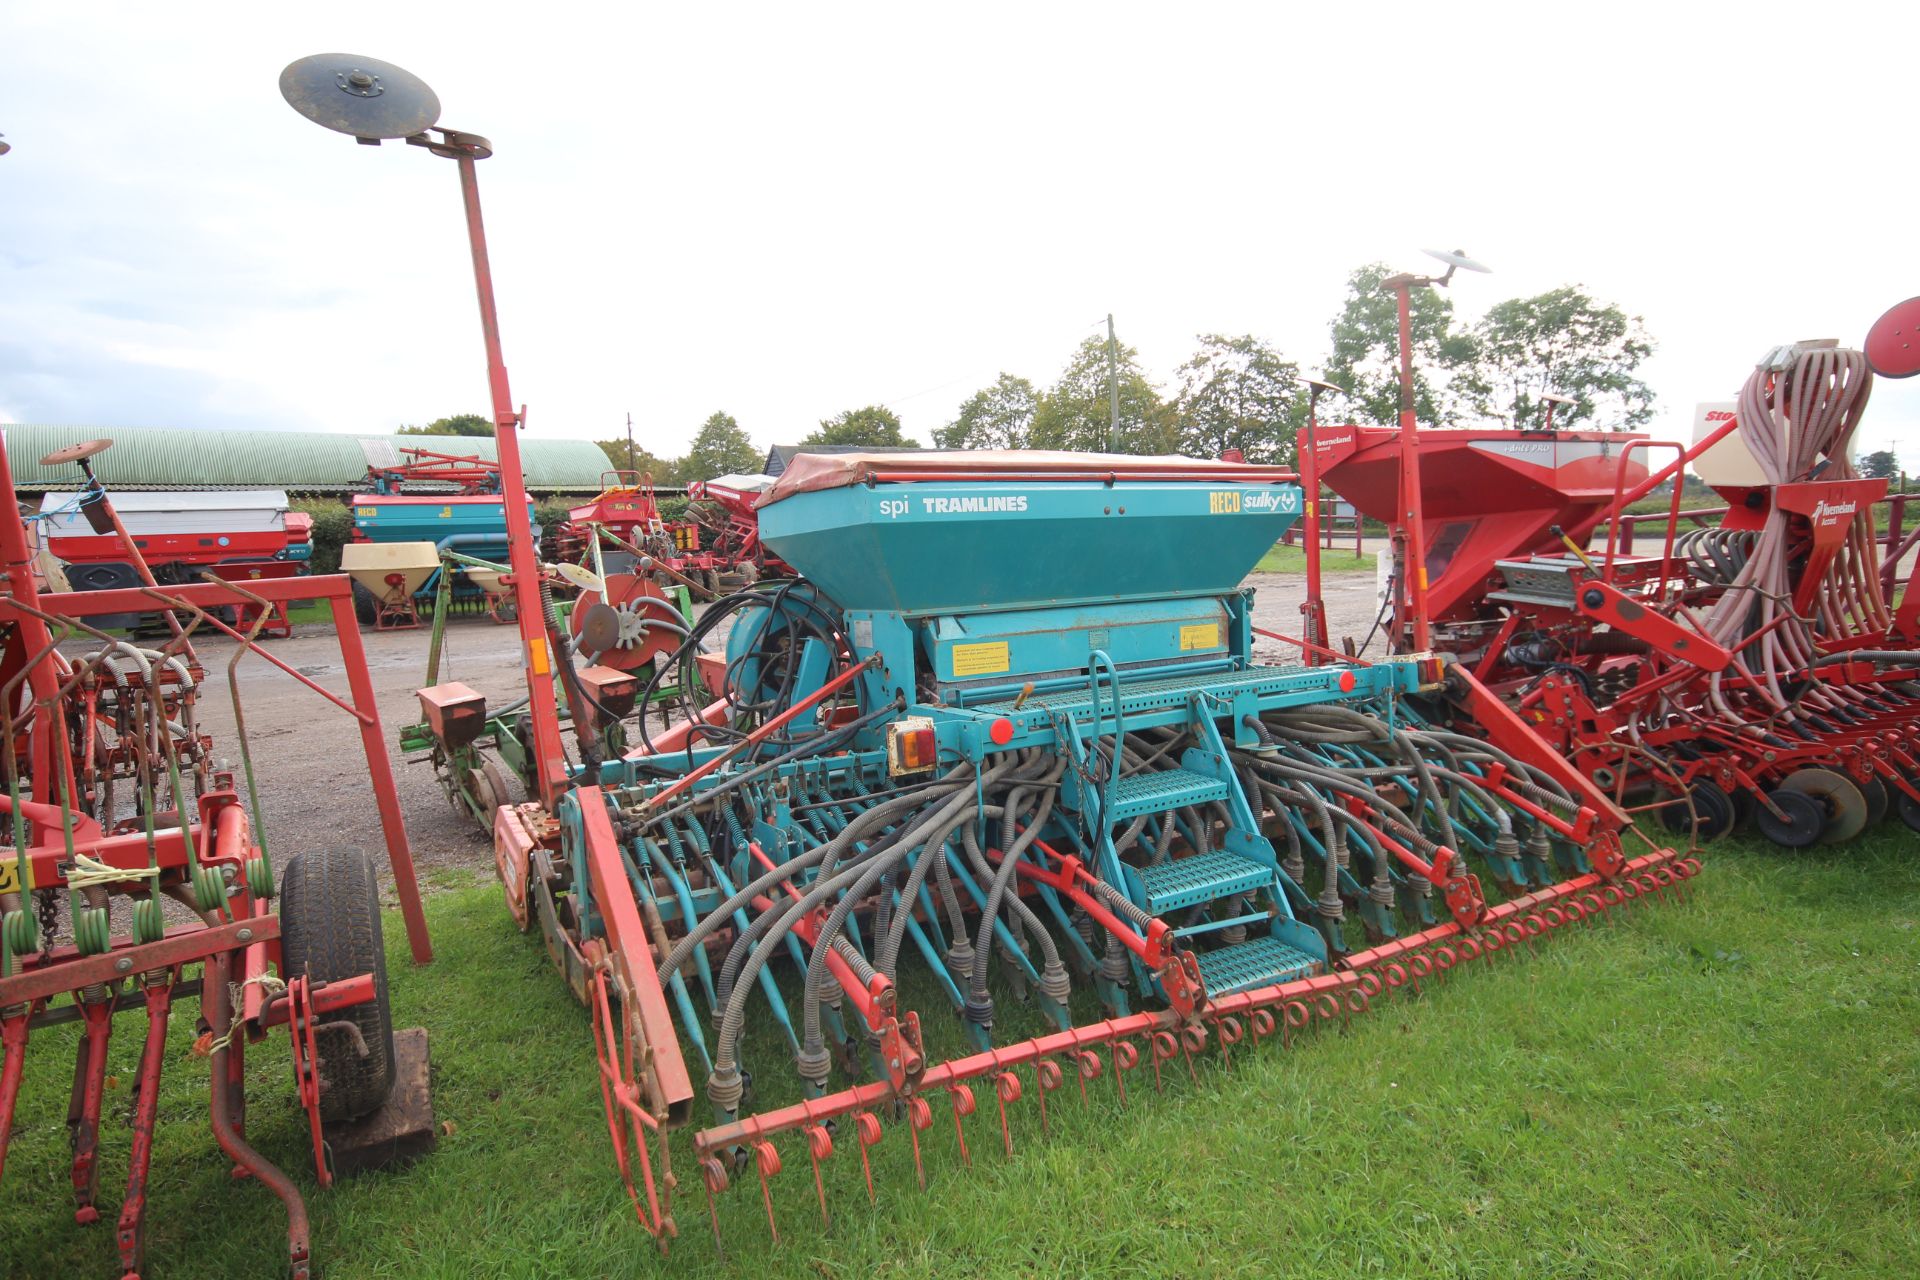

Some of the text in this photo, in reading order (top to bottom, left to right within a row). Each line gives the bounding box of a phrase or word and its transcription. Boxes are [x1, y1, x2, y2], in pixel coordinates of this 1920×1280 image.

[1704, 410, 1737, 422] Sto
[1531, 443, 1550, 453] PRO
[879, 495, 1028, 518] spi TRAMLINES
[1210, 491, 1281, 514] RECO sulky
[1822, 500, 1857, 516] Kverneland
[357, 507, 377, 517] RECO
